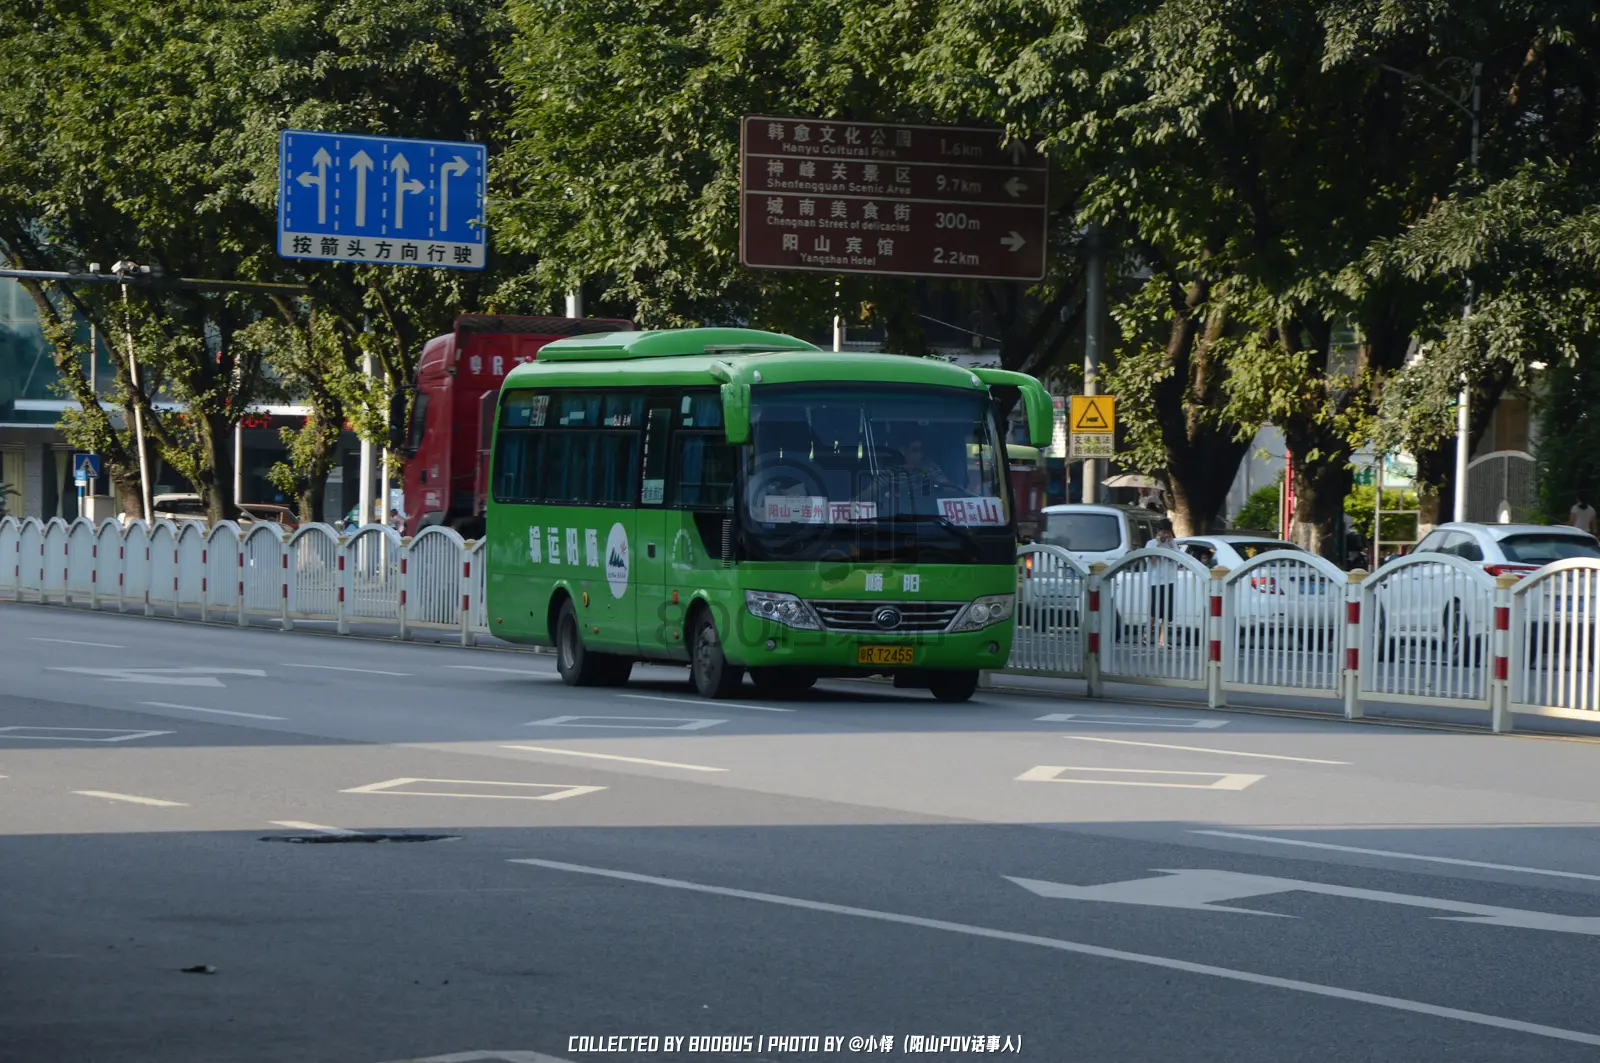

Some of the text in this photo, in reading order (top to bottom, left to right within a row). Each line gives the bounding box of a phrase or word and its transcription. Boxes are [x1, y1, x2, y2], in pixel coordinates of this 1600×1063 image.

[767, 122, 912, 147] 韩愈文化公园
[782, 142, 897, 158] Hanyu Cultural Park
[940, 138, 982, 157] 1.6km
[766, 159, 911, 184] 神峰关景区
[767, 178, 911, 195] Shenfengguan Scenic Area
[935, 175, 982, 194] 9.7km
[766, 196, 911, 221] 城南美食街
[766, 216, 910, 232] Chengnan Street of delicacies
[935, 211, 980, 230] 300m
[292, 235, 472, 264] 按箭头方向行驶
[782, 233, 894, 257] 阳山宾馆
[800, 252, 876, 266] Yangshan Hotel
[933, 248, 979, 265] 2.2km
[864, 573, 920, 593] 顺阳
